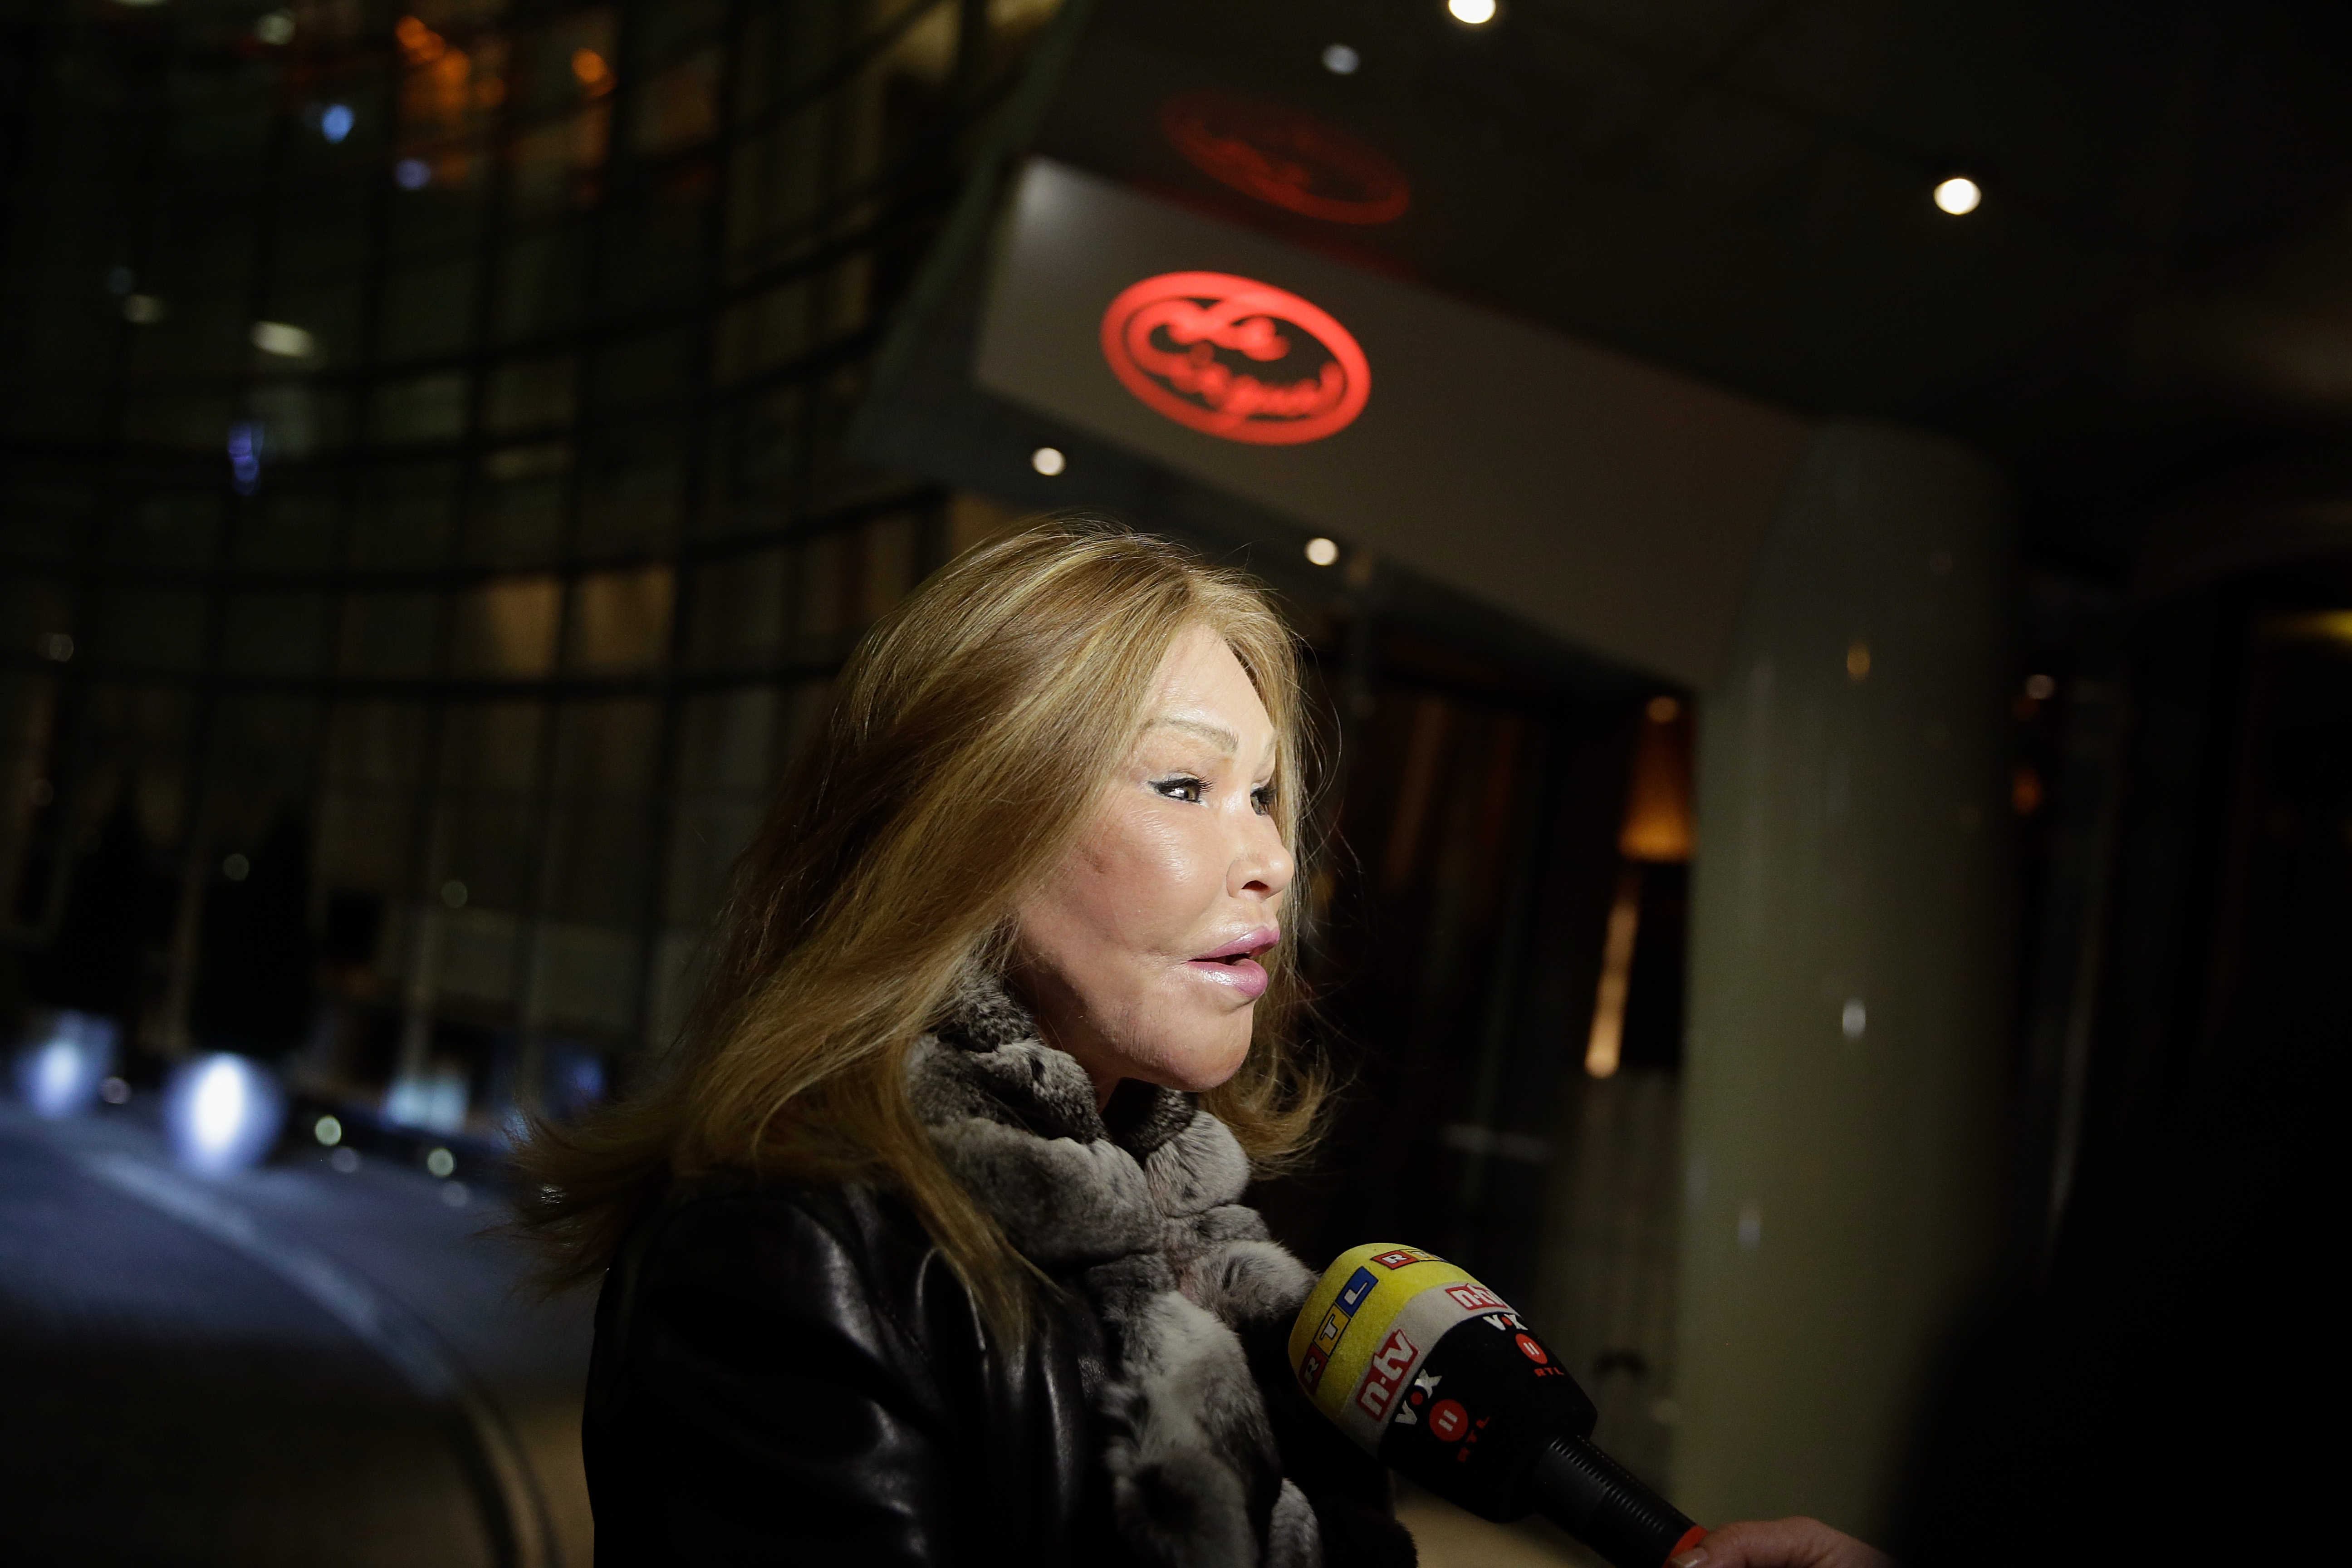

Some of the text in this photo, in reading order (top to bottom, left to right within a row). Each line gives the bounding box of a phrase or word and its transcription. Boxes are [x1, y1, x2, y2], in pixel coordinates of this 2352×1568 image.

[1303, 1279, 1369, 1385] RTL
[1533, 1366, 1565, 1378] RTL
[1456, 1416, 1491, 1463] RTL
